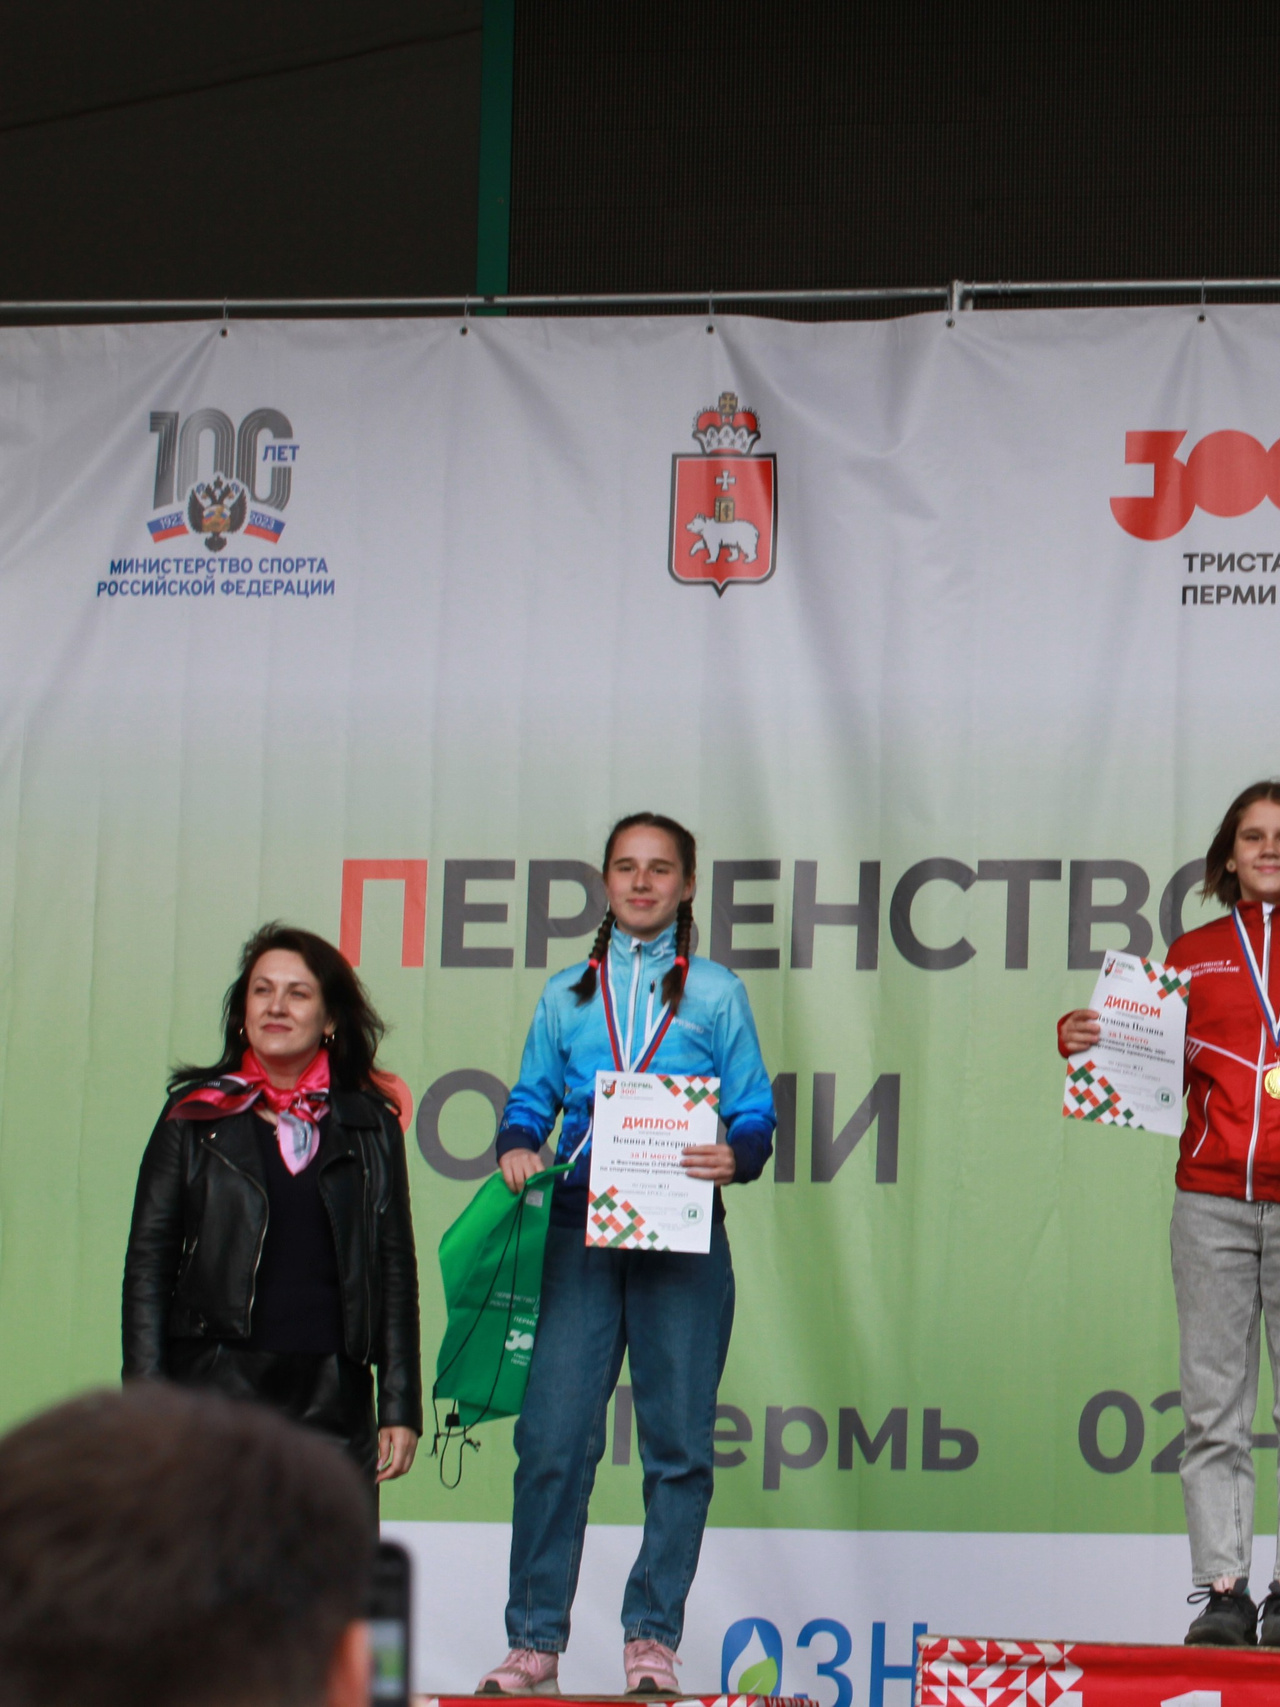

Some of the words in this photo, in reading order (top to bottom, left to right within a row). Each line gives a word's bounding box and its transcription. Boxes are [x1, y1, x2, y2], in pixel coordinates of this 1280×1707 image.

[262, 445, 299, 462] ЛЕТ
[109, 557, 253, 576] МИНИСТЕРСТВО
[258, 557, 328, 574] СПОРТА
[96, 575, 215, 597] РОССИЙСКОЙ
[220, 579, 335, 598] ФЕДЕРАЦИИ
[1181, 585, 1277, 605] ПЕРМИ
[340, 857, 1209, 971] ПЕРЕНСТВ
[1104, 994, 1162, 1018] ДИПЛОМ
[622, 1116, 690, 1131] ДИПЛОМ
[505, 1329, 534, 1351] 30
